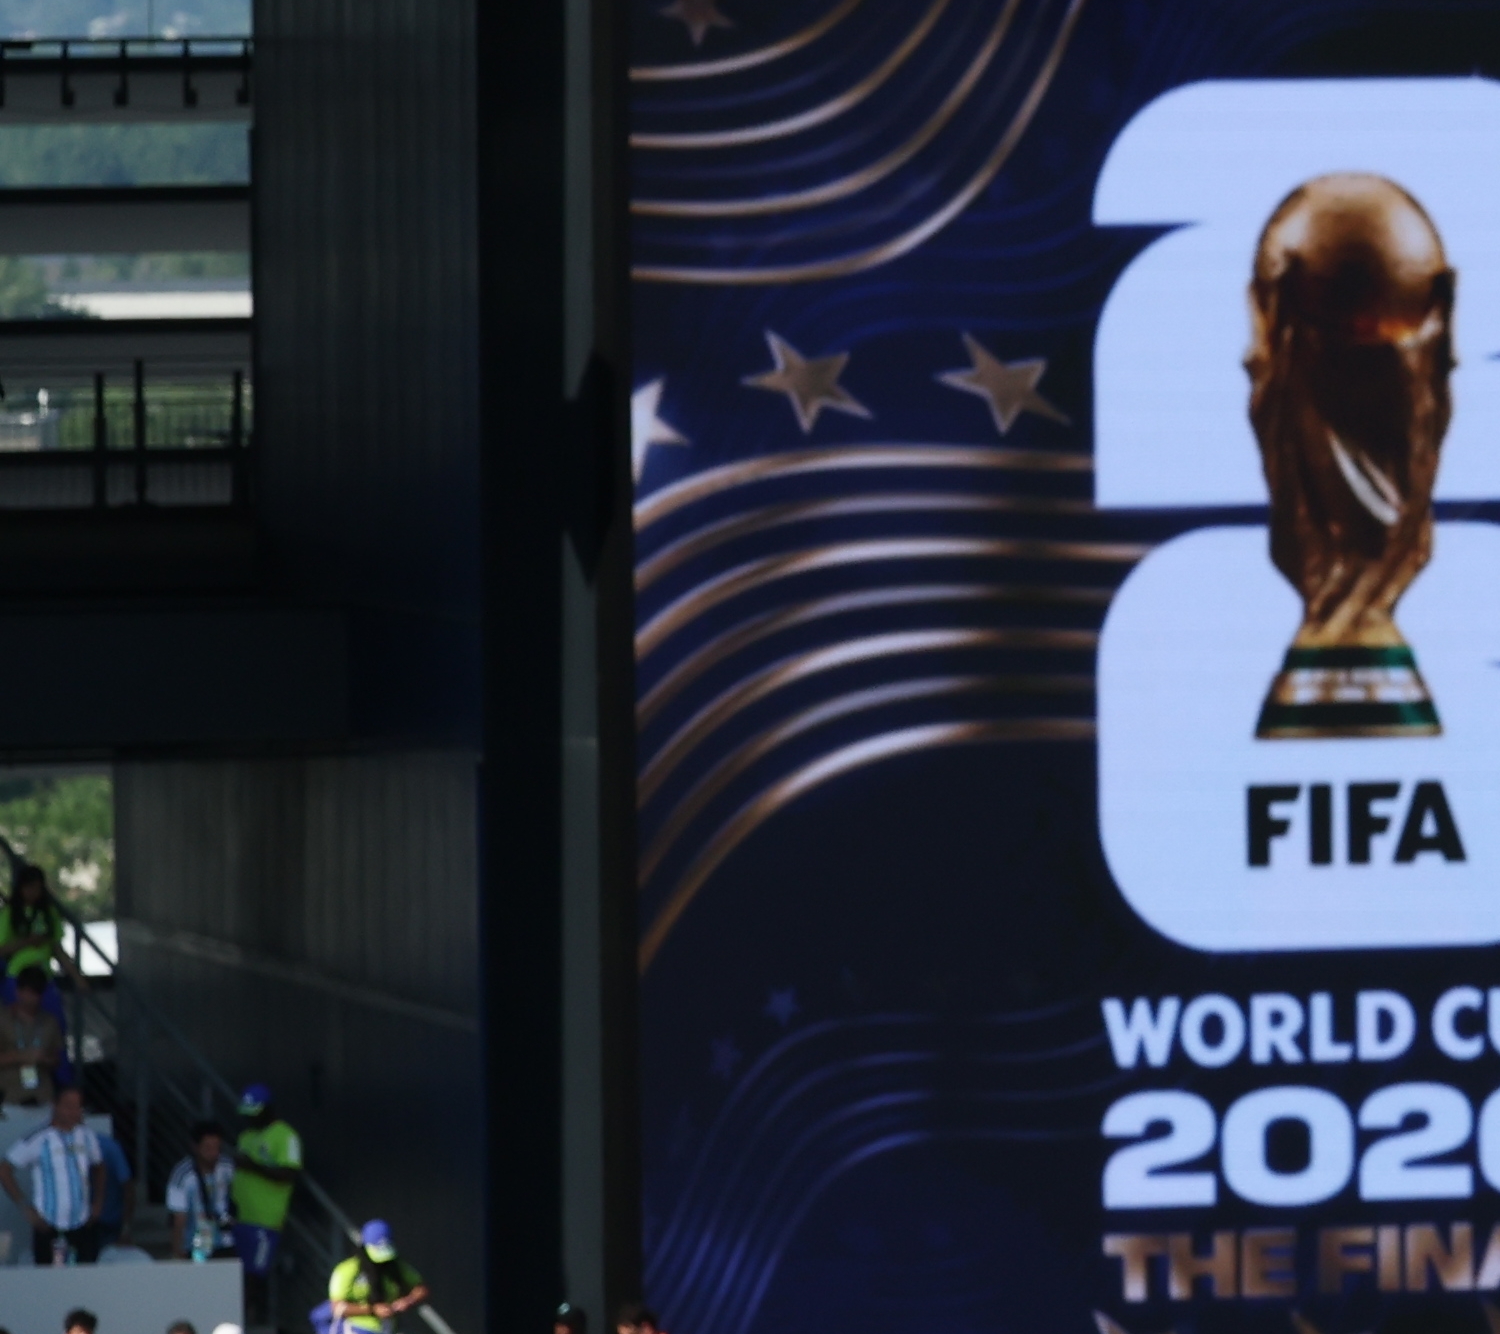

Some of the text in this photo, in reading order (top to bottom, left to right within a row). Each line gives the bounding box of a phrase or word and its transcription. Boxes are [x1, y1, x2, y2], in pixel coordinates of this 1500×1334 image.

[1246, 781, 1466, 867] FIFA
[1103, 991, 1414, 1067] WORLD
[1103, 1230, 1294, 1304] THE
